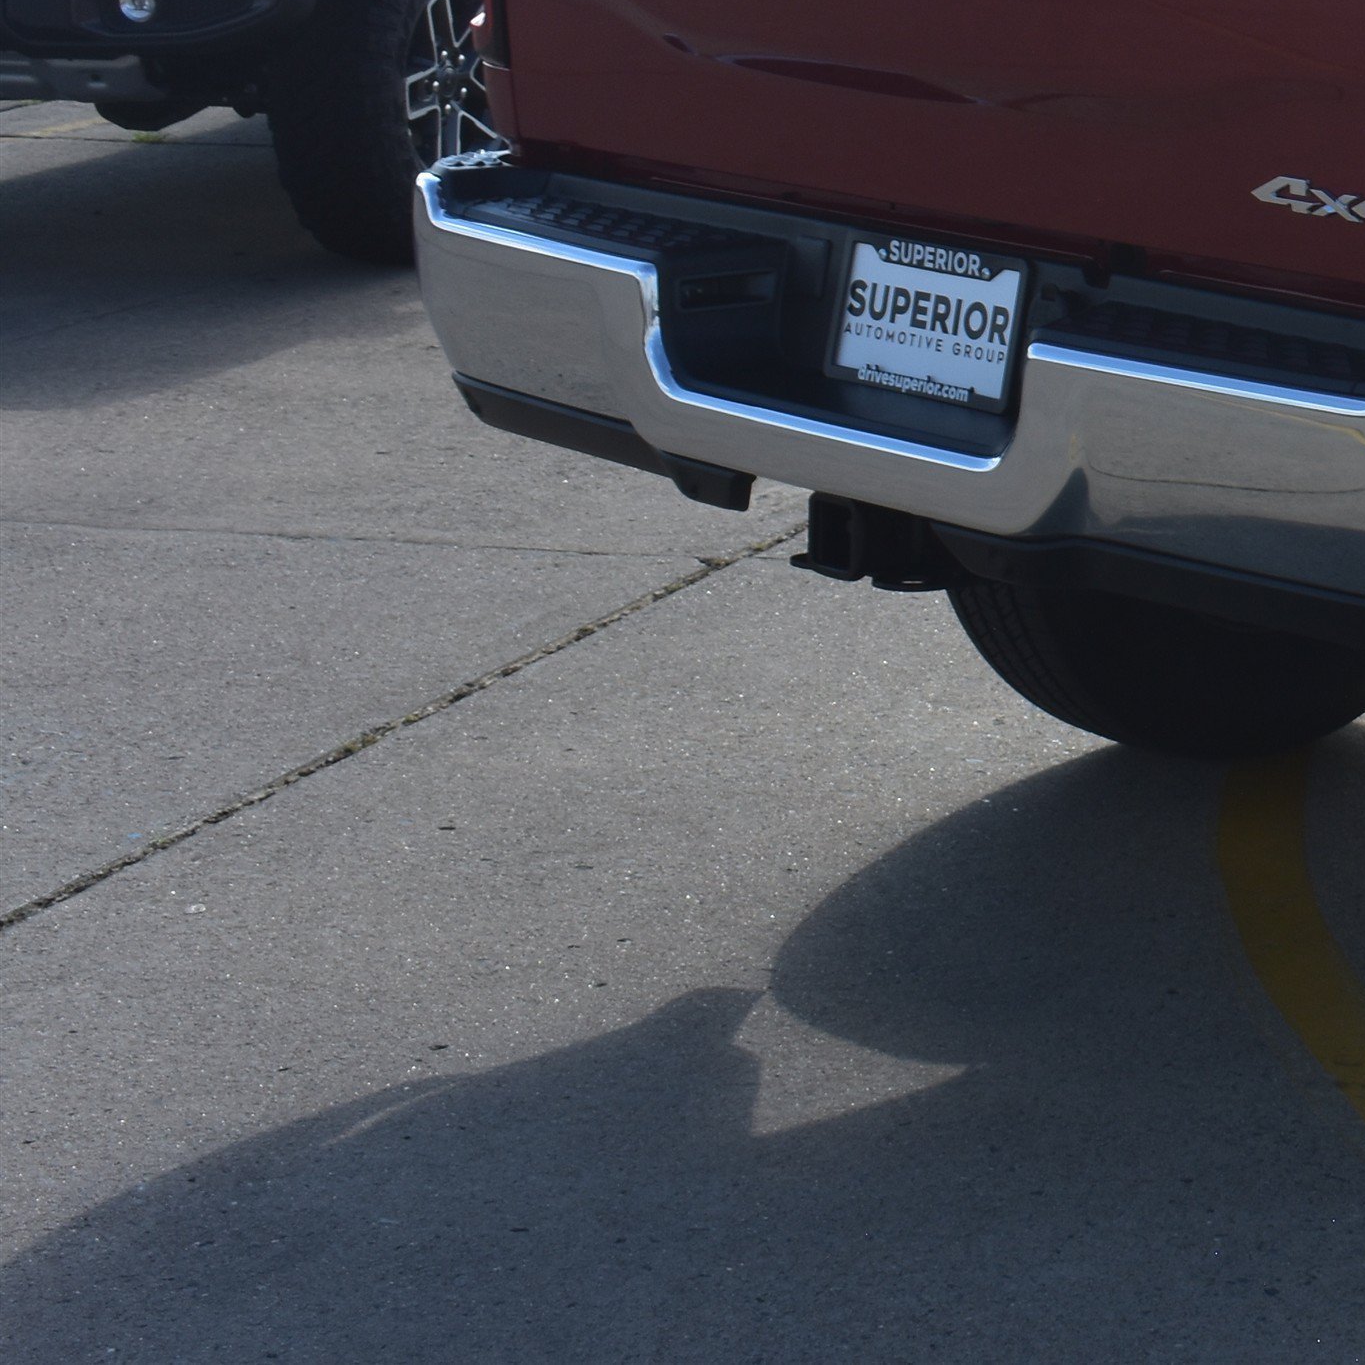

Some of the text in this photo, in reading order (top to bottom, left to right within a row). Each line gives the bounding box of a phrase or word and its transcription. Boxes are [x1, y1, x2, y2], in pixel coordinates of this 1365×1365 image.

[888, 239, 981, 277] SUPERIOR
[846, 279, 1010, 346] SUPERIOR
[843, 321, 1006, 364] AUTOMOTIVE GROUP
[857, 364, 970, 403] drivesuperior.com
